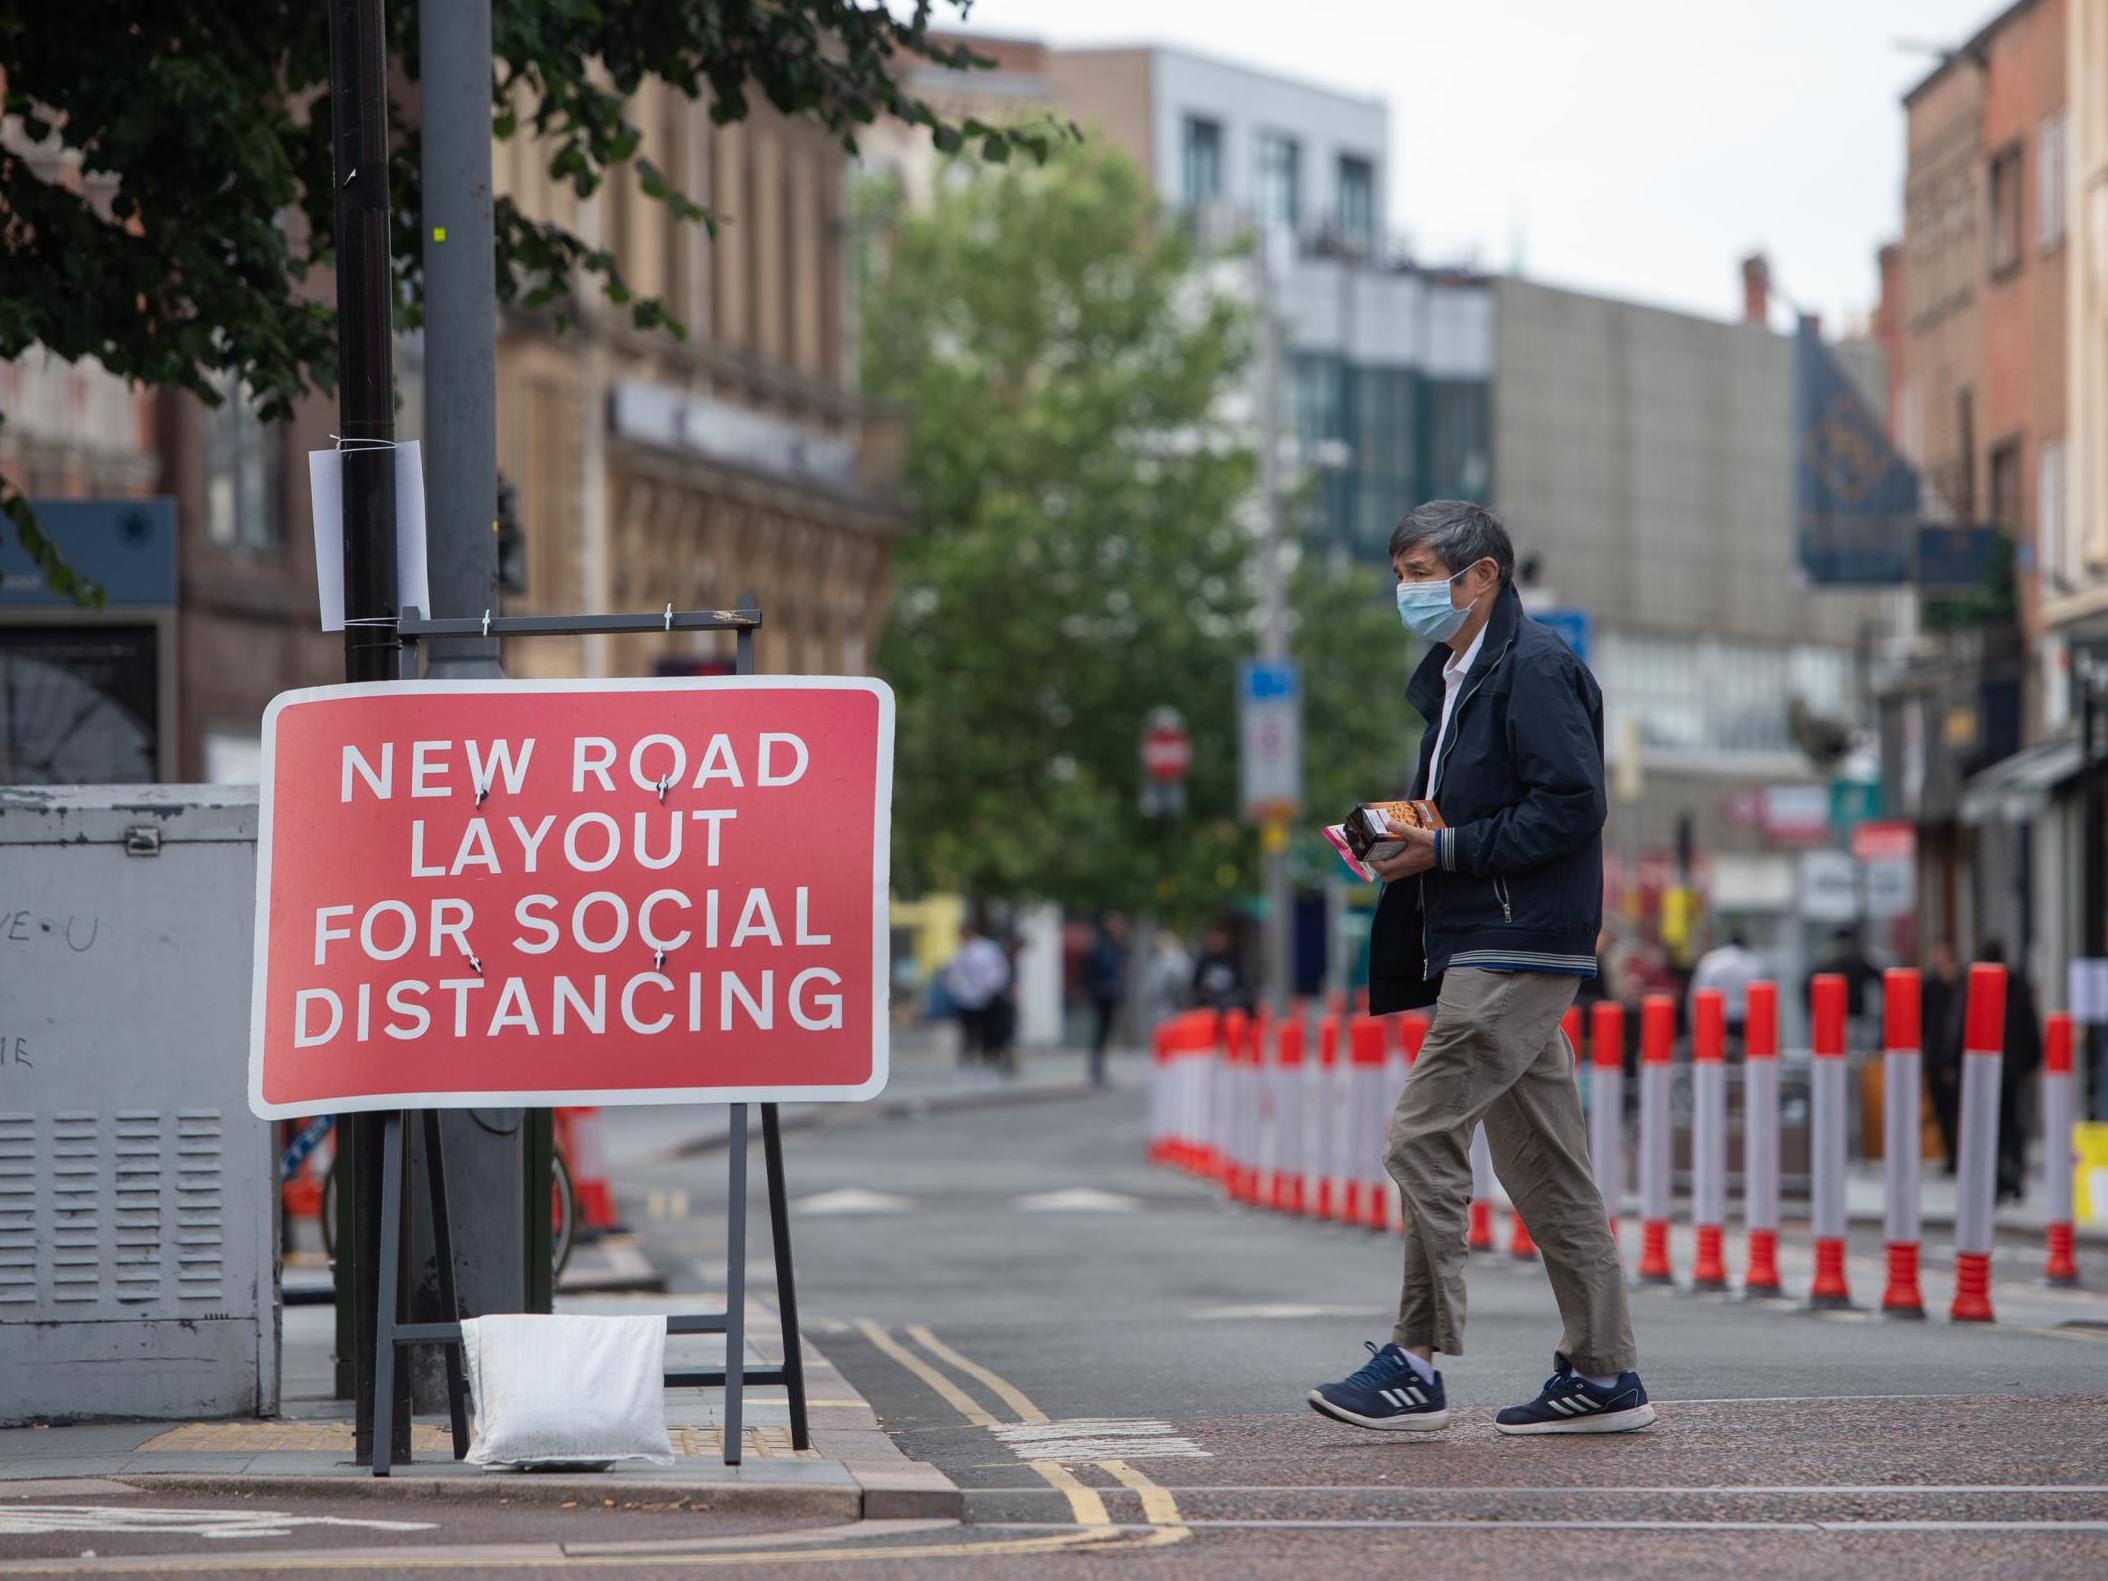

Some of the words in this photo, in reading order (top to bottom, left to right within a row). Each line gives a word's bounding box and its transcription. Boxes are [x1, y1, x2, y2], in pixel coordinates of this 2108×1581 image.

[340, 736, 536, 805] NEW
[572, 732, 810, 794] ROAD
[410, 808, 738, 878] LAYOUT
[313, 896, 475, 966] FOR
[512, 886, 833, 955] SOCIAL
[292, 966, 843, 1050] DISTANCING
